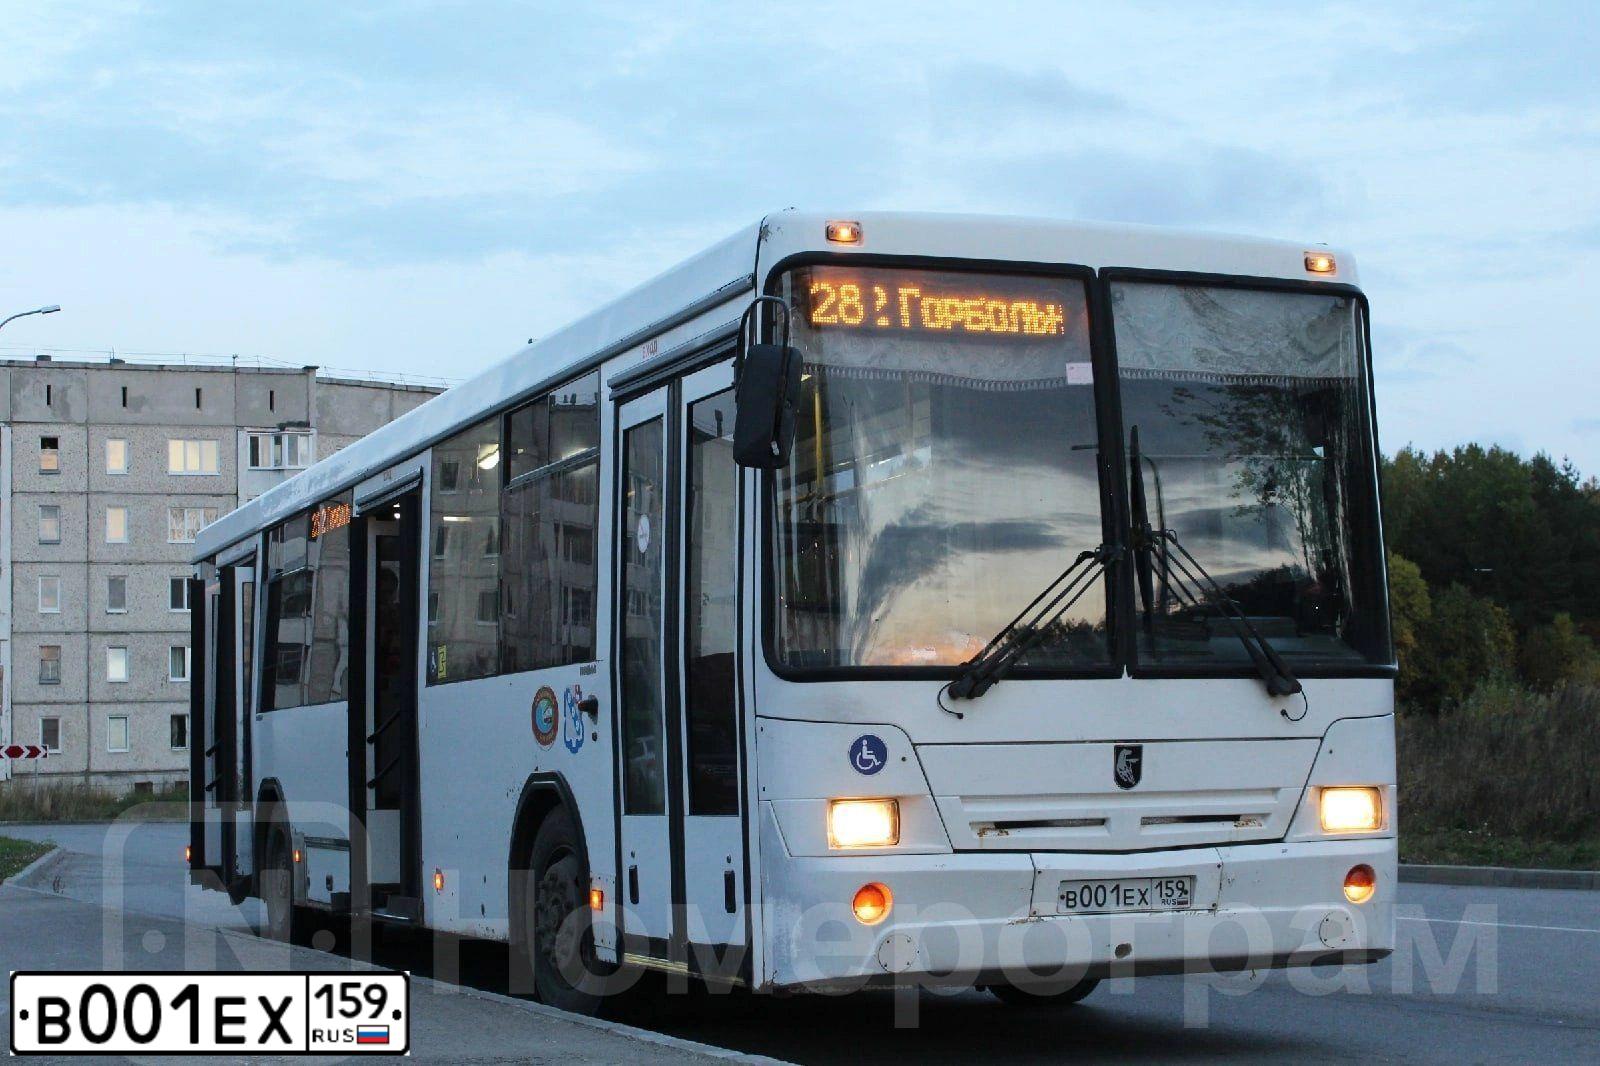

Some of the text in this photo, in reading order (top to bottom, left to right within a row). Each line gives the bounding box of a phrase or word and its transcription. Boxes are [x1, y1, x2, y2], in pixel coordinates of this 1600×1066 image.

[810, 282, 864, 325] 28
[1065, 880, 1185, 909] В001ЕХ 159
